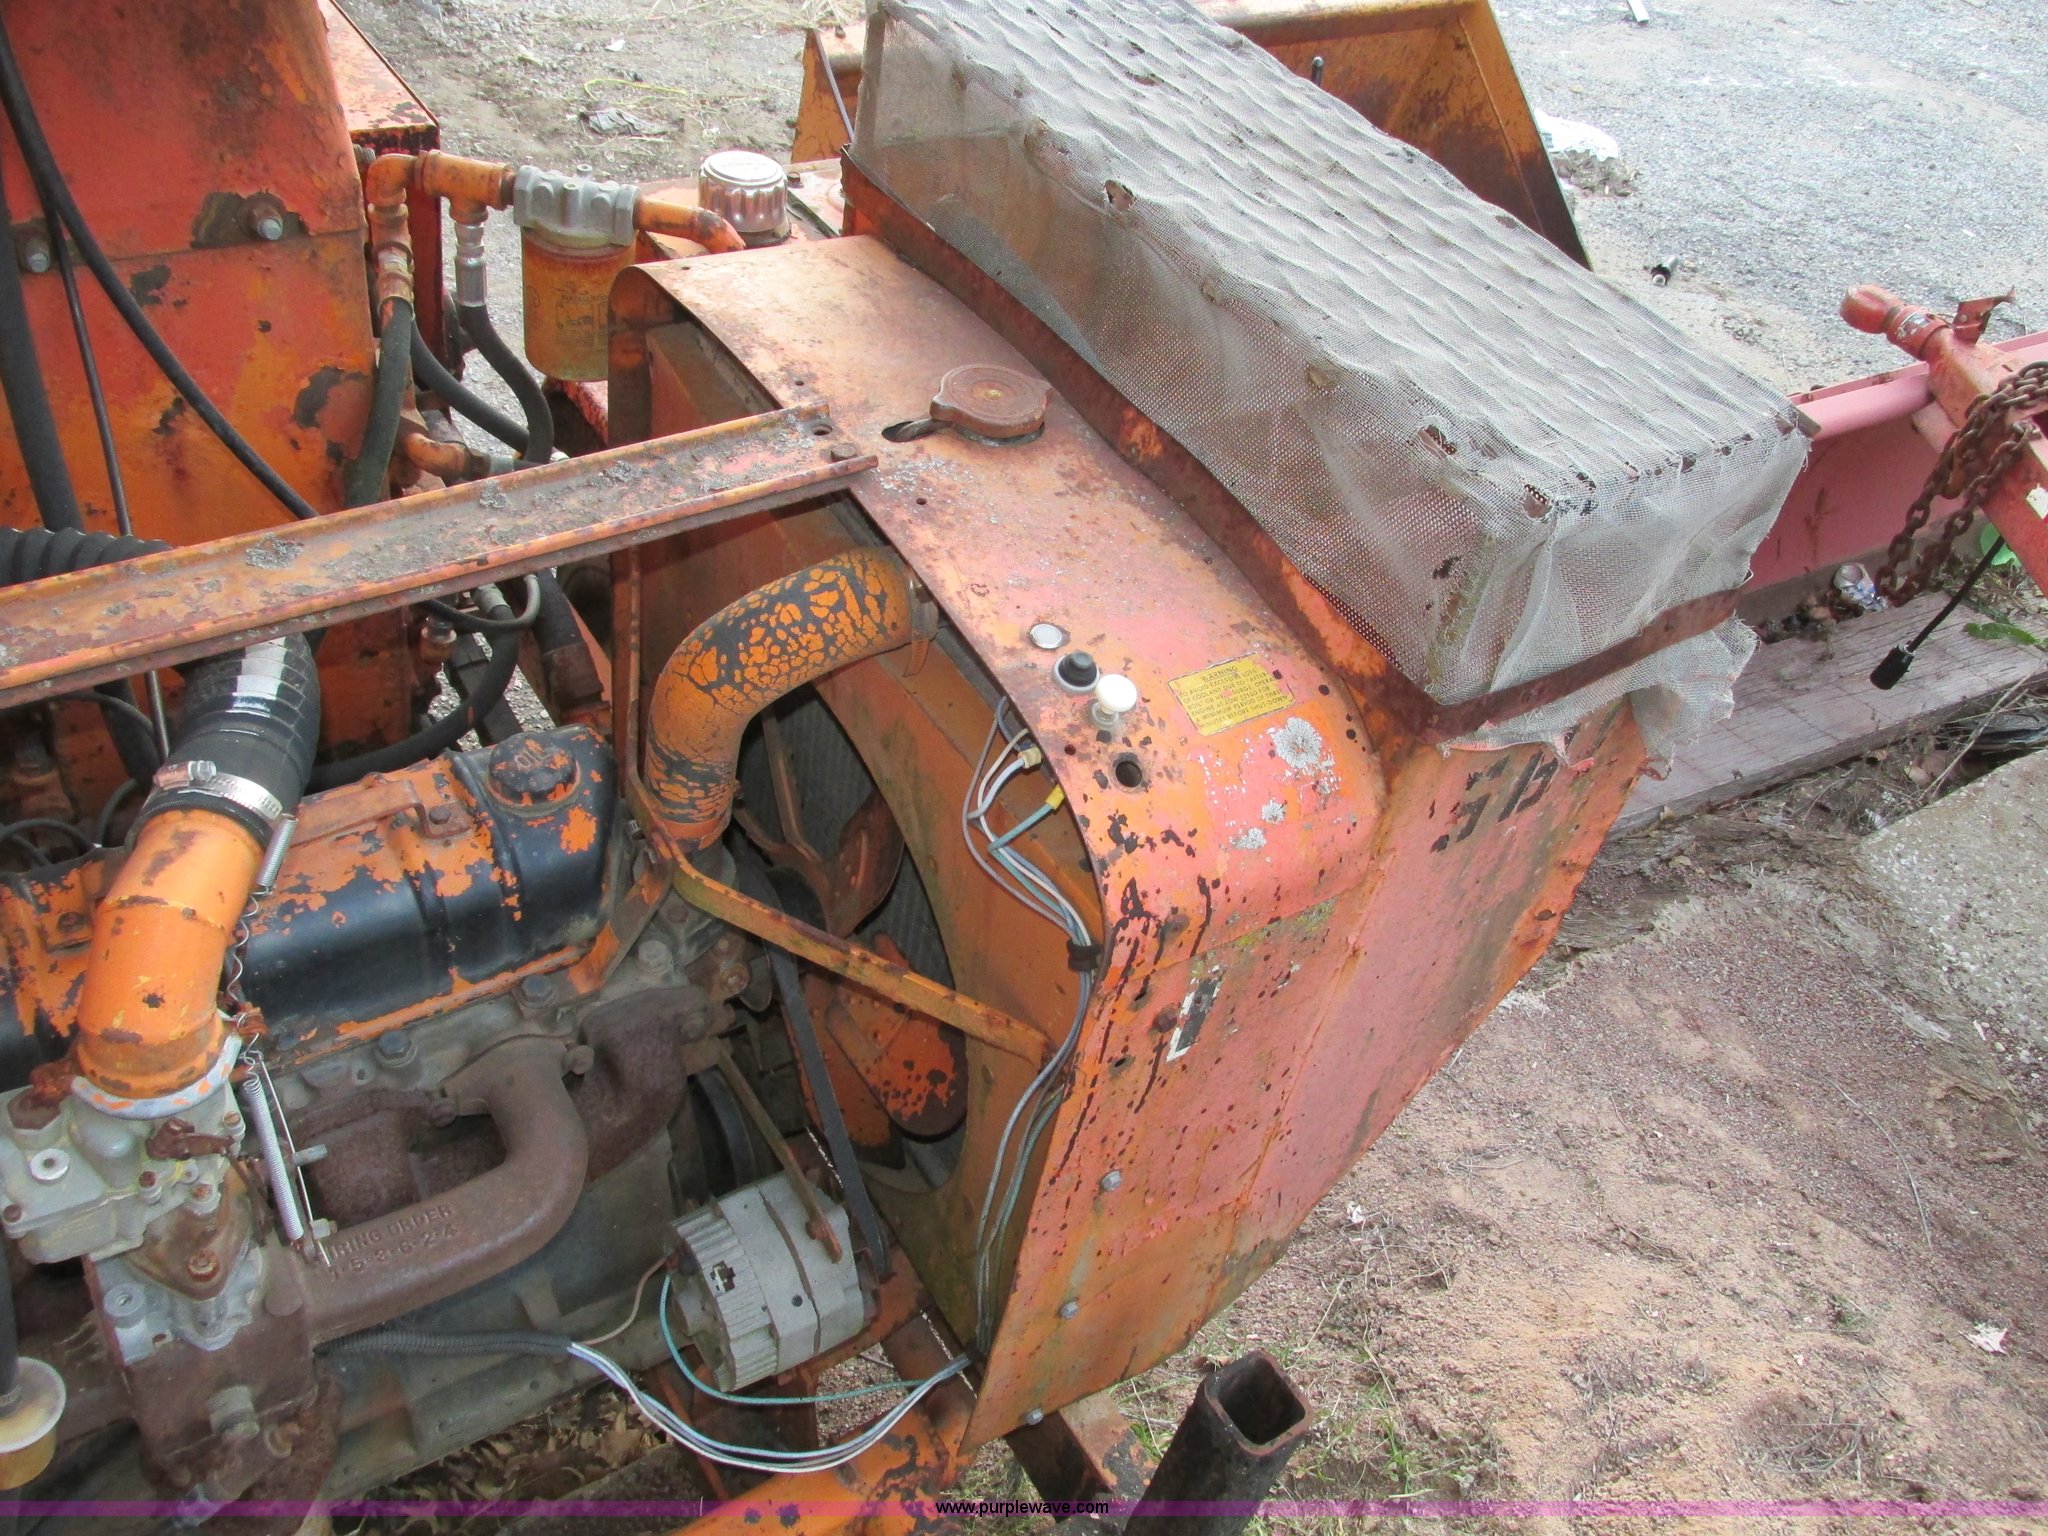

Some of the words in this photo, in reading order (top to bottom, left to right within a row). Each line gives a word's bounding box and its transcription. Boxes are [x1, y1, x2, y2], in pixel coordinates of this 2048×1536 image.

[1200, 665, 1238, 681] WARNING
[1188, 683, 1209, 694] AVOID
[1191, 687, 1222, 700] COOLANT
[1222, 682, 1235, 690] DUE
[1191, 704, 1215, 716] ENGINE
[1238, 689, 1258, 700] SPEED
[1257, 685, 1271, 693] FOR
[1201, 705, 1232, 720] MINIMUM
[1232, 697, 1256, 709] PERIOD
[1226, 707, 1249, 719] BEFORE
[322, 1228, 384, 1263] IRING
